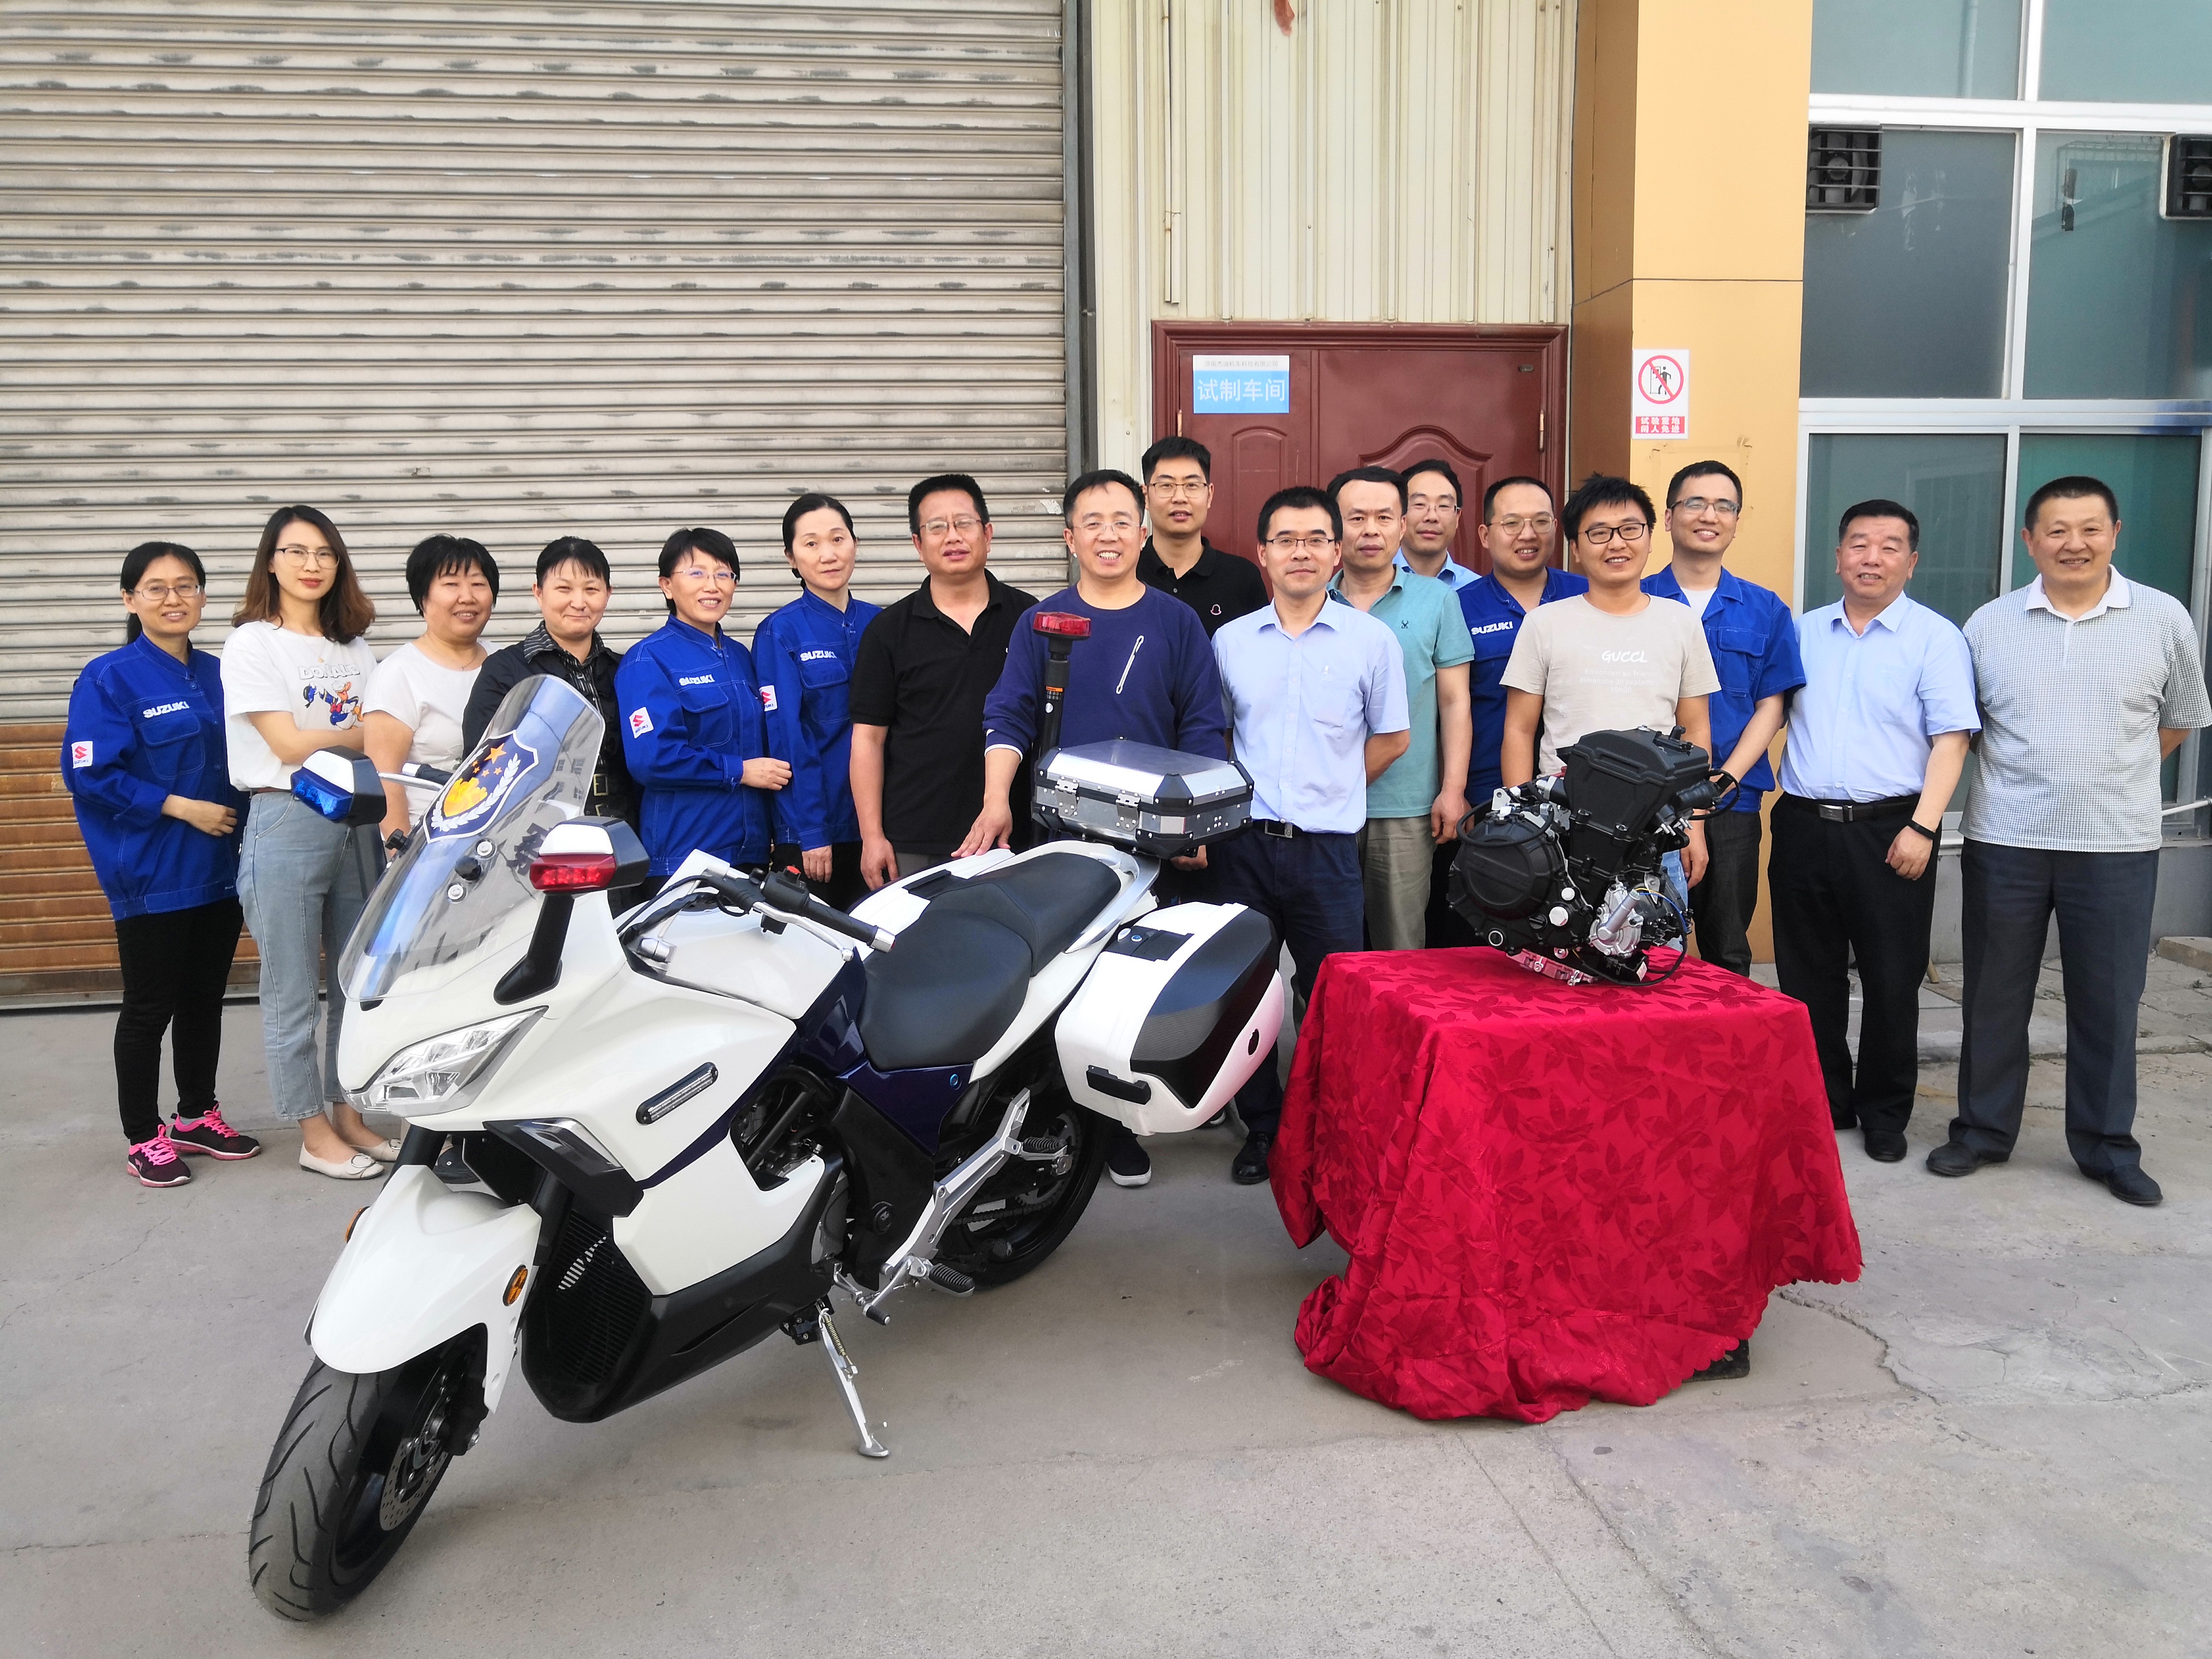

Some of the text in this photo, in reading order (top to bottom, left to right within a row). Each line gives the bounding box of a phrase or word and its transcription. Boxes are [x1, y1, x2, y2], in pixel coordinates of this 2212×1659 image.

[1198, 379, 1286, 401] 试制车间
[1641, 417, 1680, 425] 试验重地
[1471, 621, 1513, 635] SUZUKI
[800, 650, 837, 661] SUZUKI
[298, 664, 361, 680] DONALD
[679, 674, 715, 685] SUZUKI
[143, 701, 190, 718] SUZUKI
